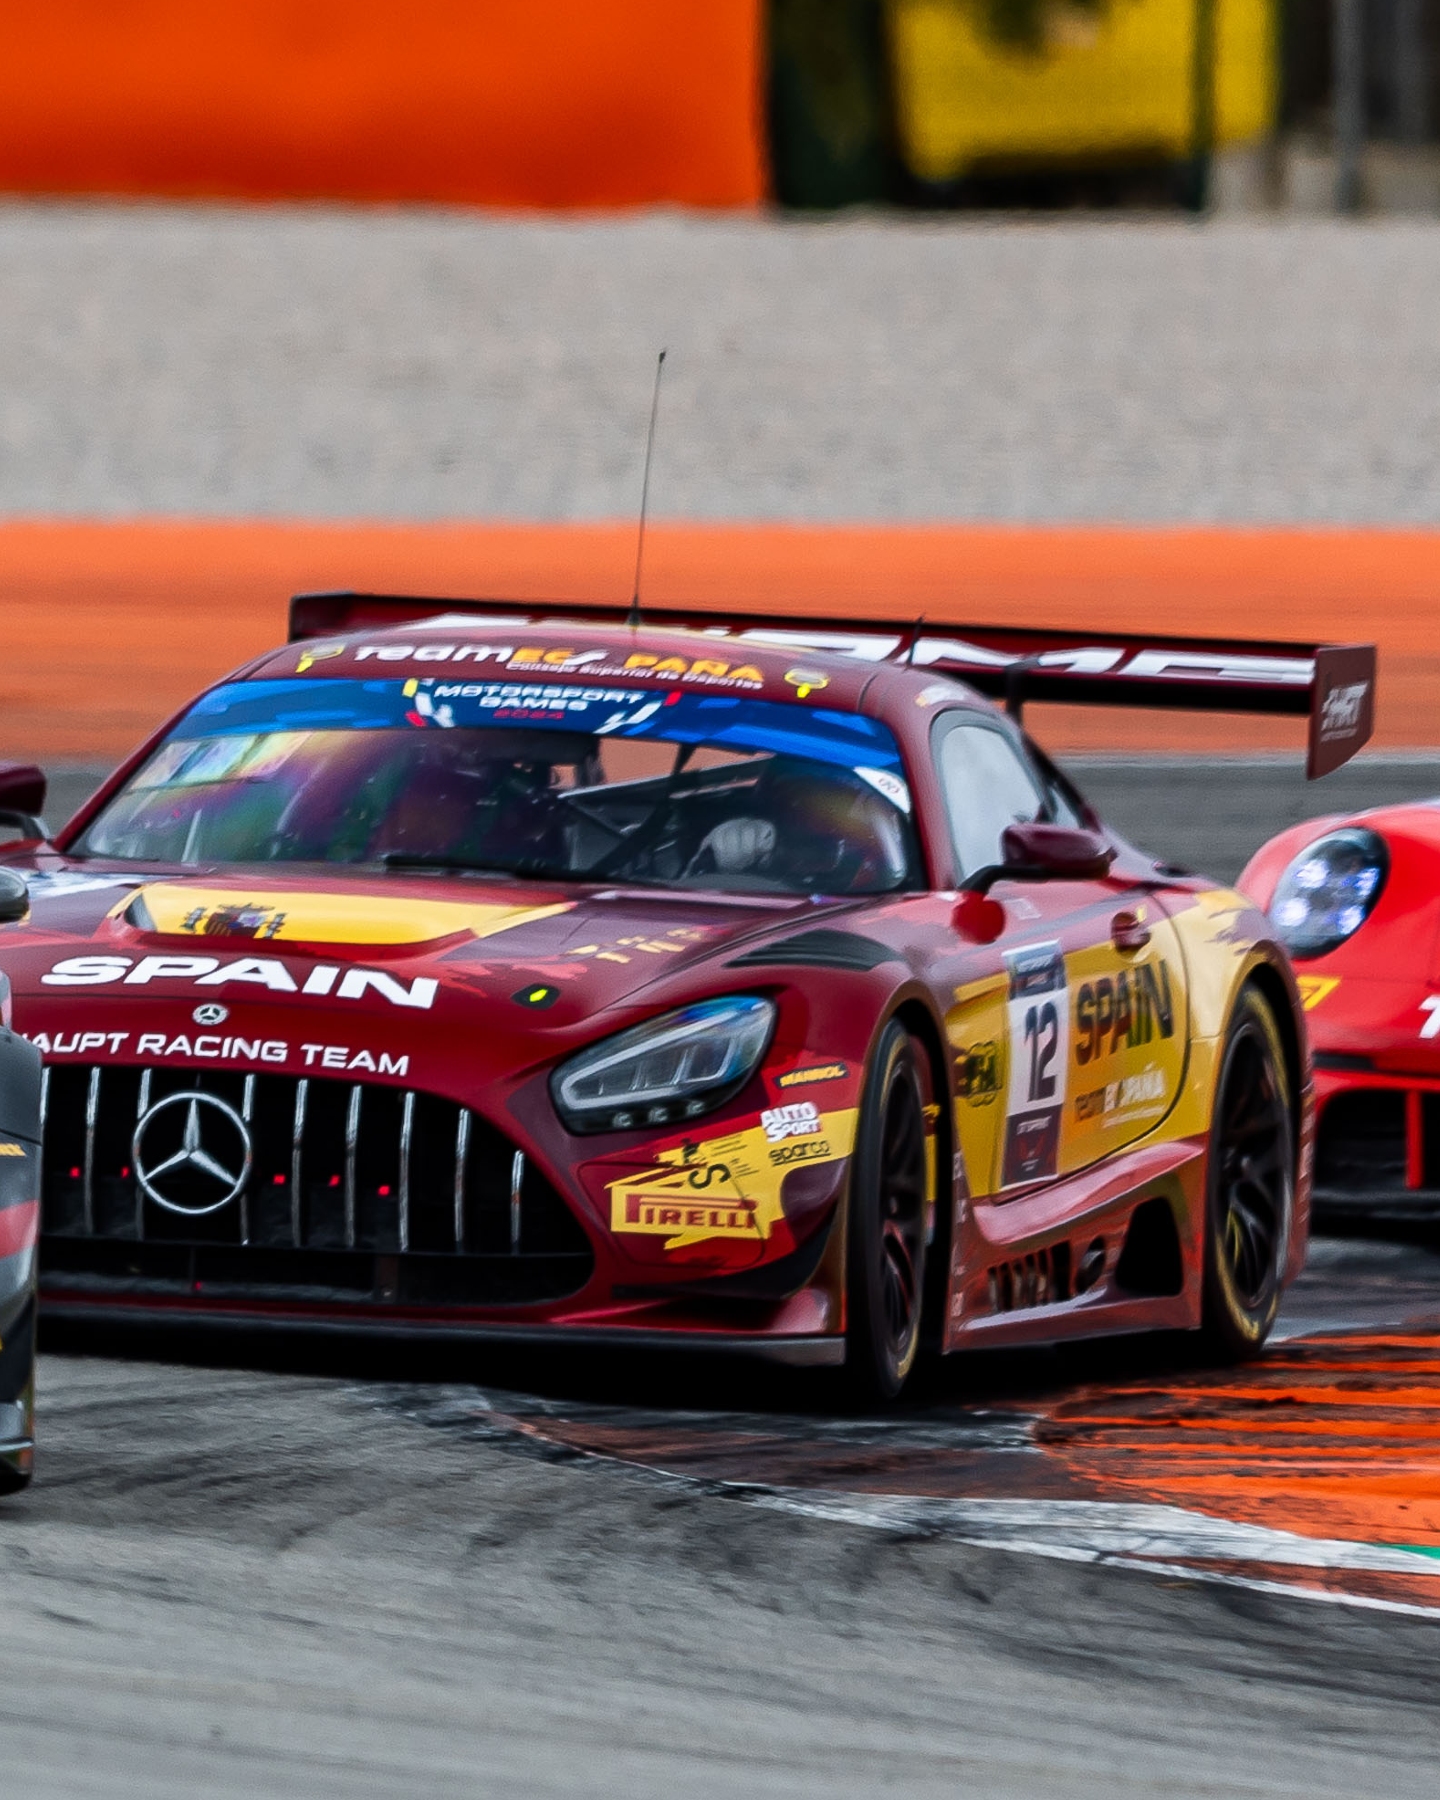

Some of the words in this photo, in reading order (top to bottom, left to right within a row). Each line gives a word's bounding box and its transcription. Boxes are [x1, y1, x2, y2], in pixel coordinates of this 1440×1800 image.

[433, 684, 647, 704] MOTORSPORT
[479, 696, 589, 711] GAMES
[493, 709, 565, 719] 2024
[40, 955, 440, 1009] SPAIN
[1075, 958, 1174, 1067] SPAIN
[24, 1031, 129, 1054] AUPT
[136, 1033, 288, 1063] RACING
[299, 1044, 410, 1077] TEAM
[1024, 1001, 1058, 1102] 12
[768, 1140, 830, 1166] sparco
[625, 1194, 759, 1229] PIRELLI
